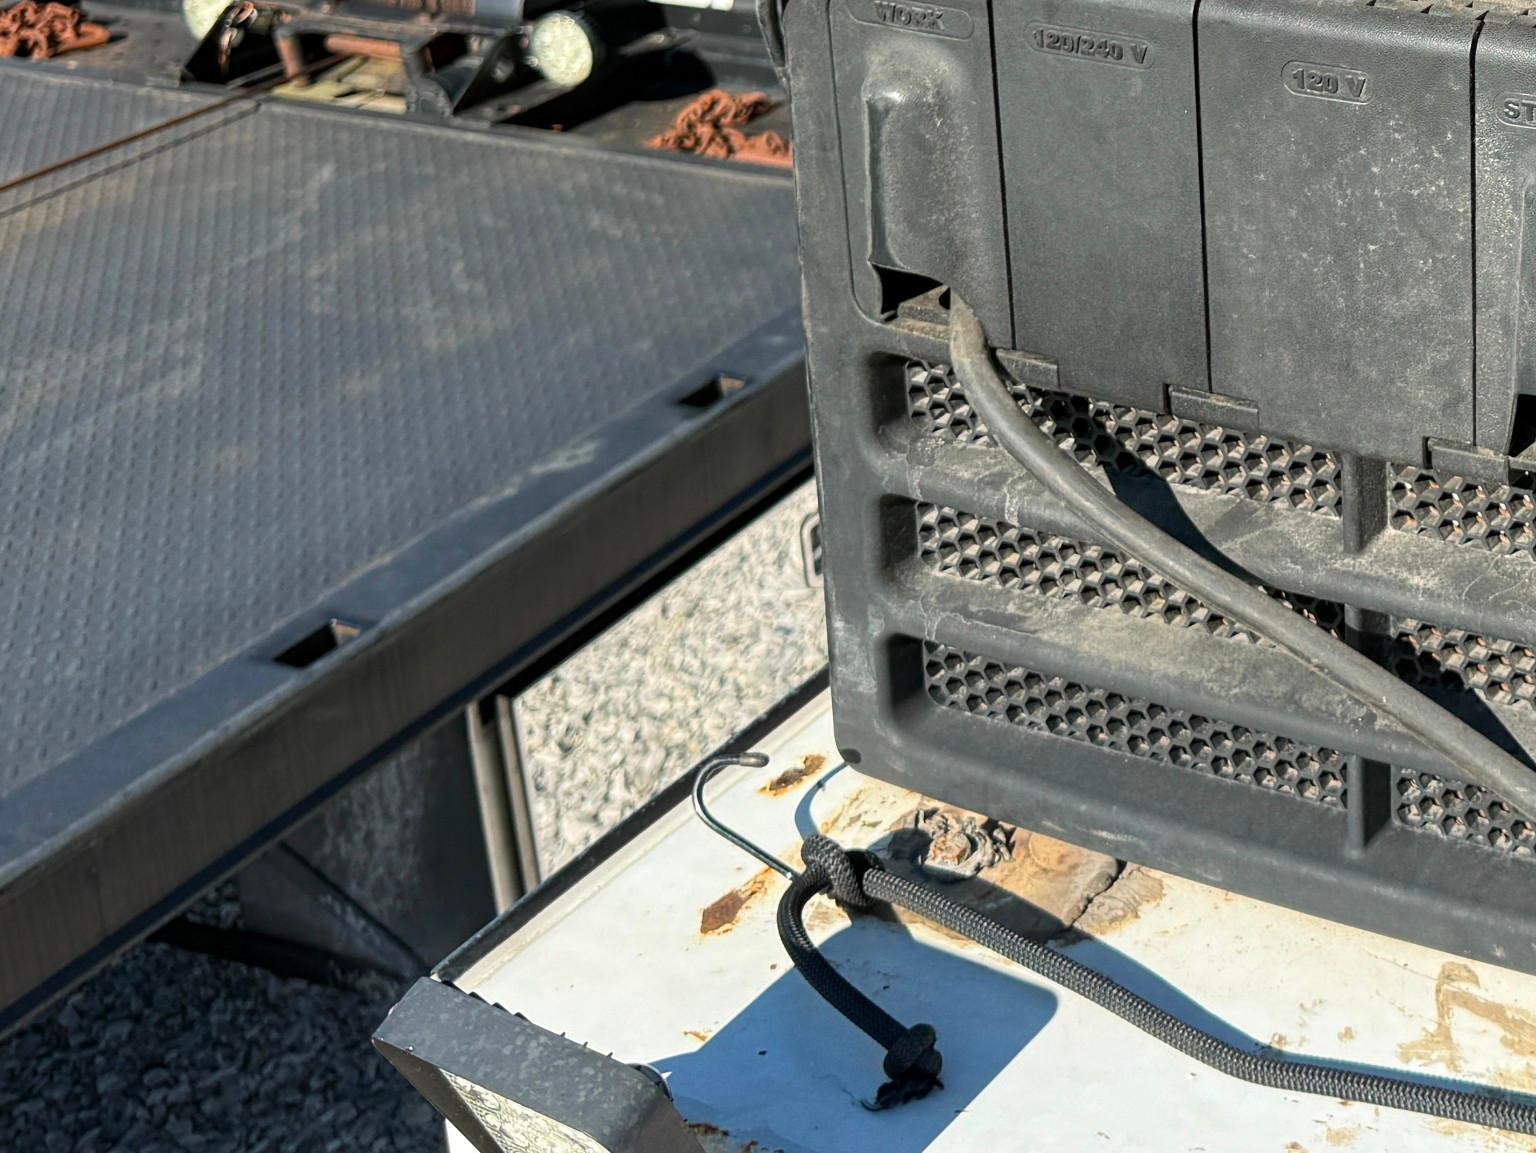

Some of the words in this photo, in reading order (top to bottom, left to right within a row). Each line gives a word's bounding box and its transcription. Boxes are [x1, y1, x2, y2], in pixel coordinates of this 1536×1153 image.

[874, 0, 945, 32] WORK
[1032, 26, 1124, 62] 120/240
[1130, 43, 1149, 65] V
[1291, 67, 1339, 95] 120
[1344, 76, 1367, 99] V
